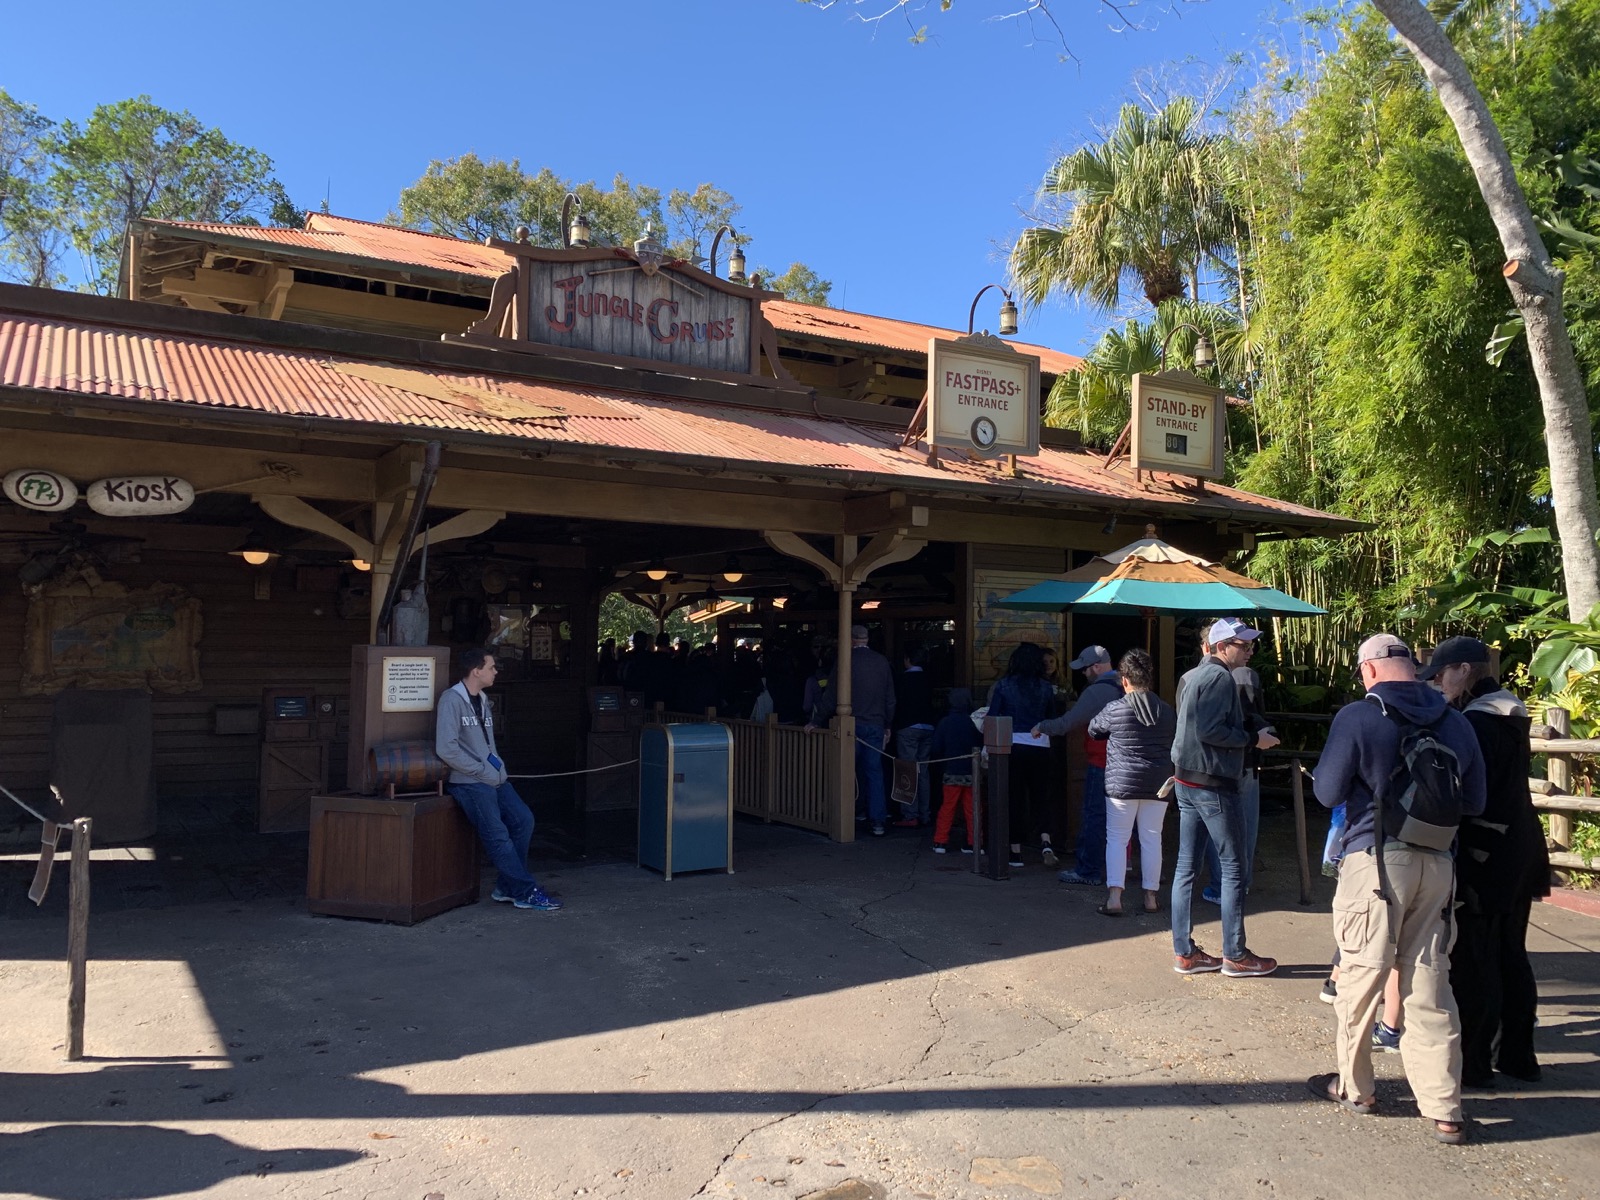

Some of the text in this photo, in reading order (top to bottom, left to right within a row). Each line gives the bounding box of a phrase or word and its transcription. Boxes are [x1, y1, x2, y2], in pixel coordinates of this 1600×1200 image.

[976, 368, 993, 376] DISNEY
[945, 371, 1022, 397] FASTPASS+
[957, 393, 1009, 411] ENTRANCE
[1147, 396, 1207, 419] STAND-BY
[1156, 416, 1198, 432] ENTRANCE
[1166, 436, 1178, 449] 80
[22, 478, 57, 501] FP+
